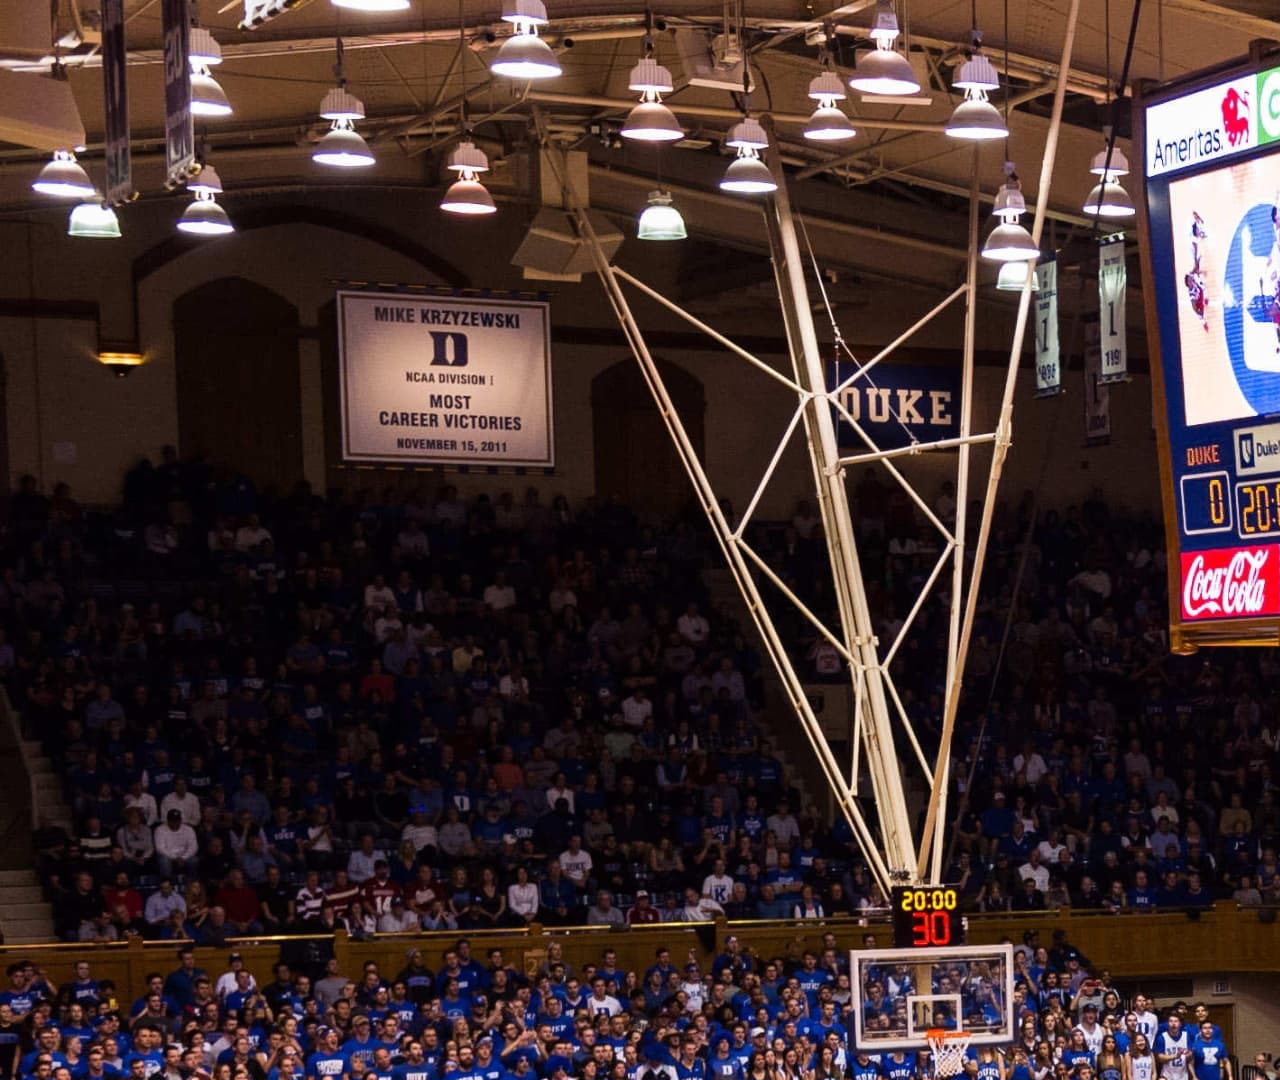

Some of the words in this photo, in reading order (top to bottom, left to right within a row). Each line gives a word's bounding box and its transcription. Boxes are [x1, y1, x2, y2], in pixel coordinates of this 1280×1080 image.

[374, 306, 414, 324] MIKE
[421, 309, 520, 329] KRZYZEWSKI
[1108, 301, 1117, 336] 1
[429, 331, 468, 366] D
[406, 371, 435, 384] NCAA
[439, 373, 485, 385] DIVISION
[430, 394, 471, 409] MOST
[839, 387, 952, 426] DUKE
[379, 411, 438, 427] CAREER
[444, 414, 522, 431] VICTORIES
[397, 438, 457, 451] NOVEMBER
[461, 441, 478, 453] 15,
[481, 441, 507, 453] 2011
[1186, 445, 1220, 466] DUKE
[1209, 479, 1225, 524] 0
[1184, 549, 1268, 616] Coca-Cola
[902, 890, 956, 911] 20:00
[912, 911, 950, 946] 30
